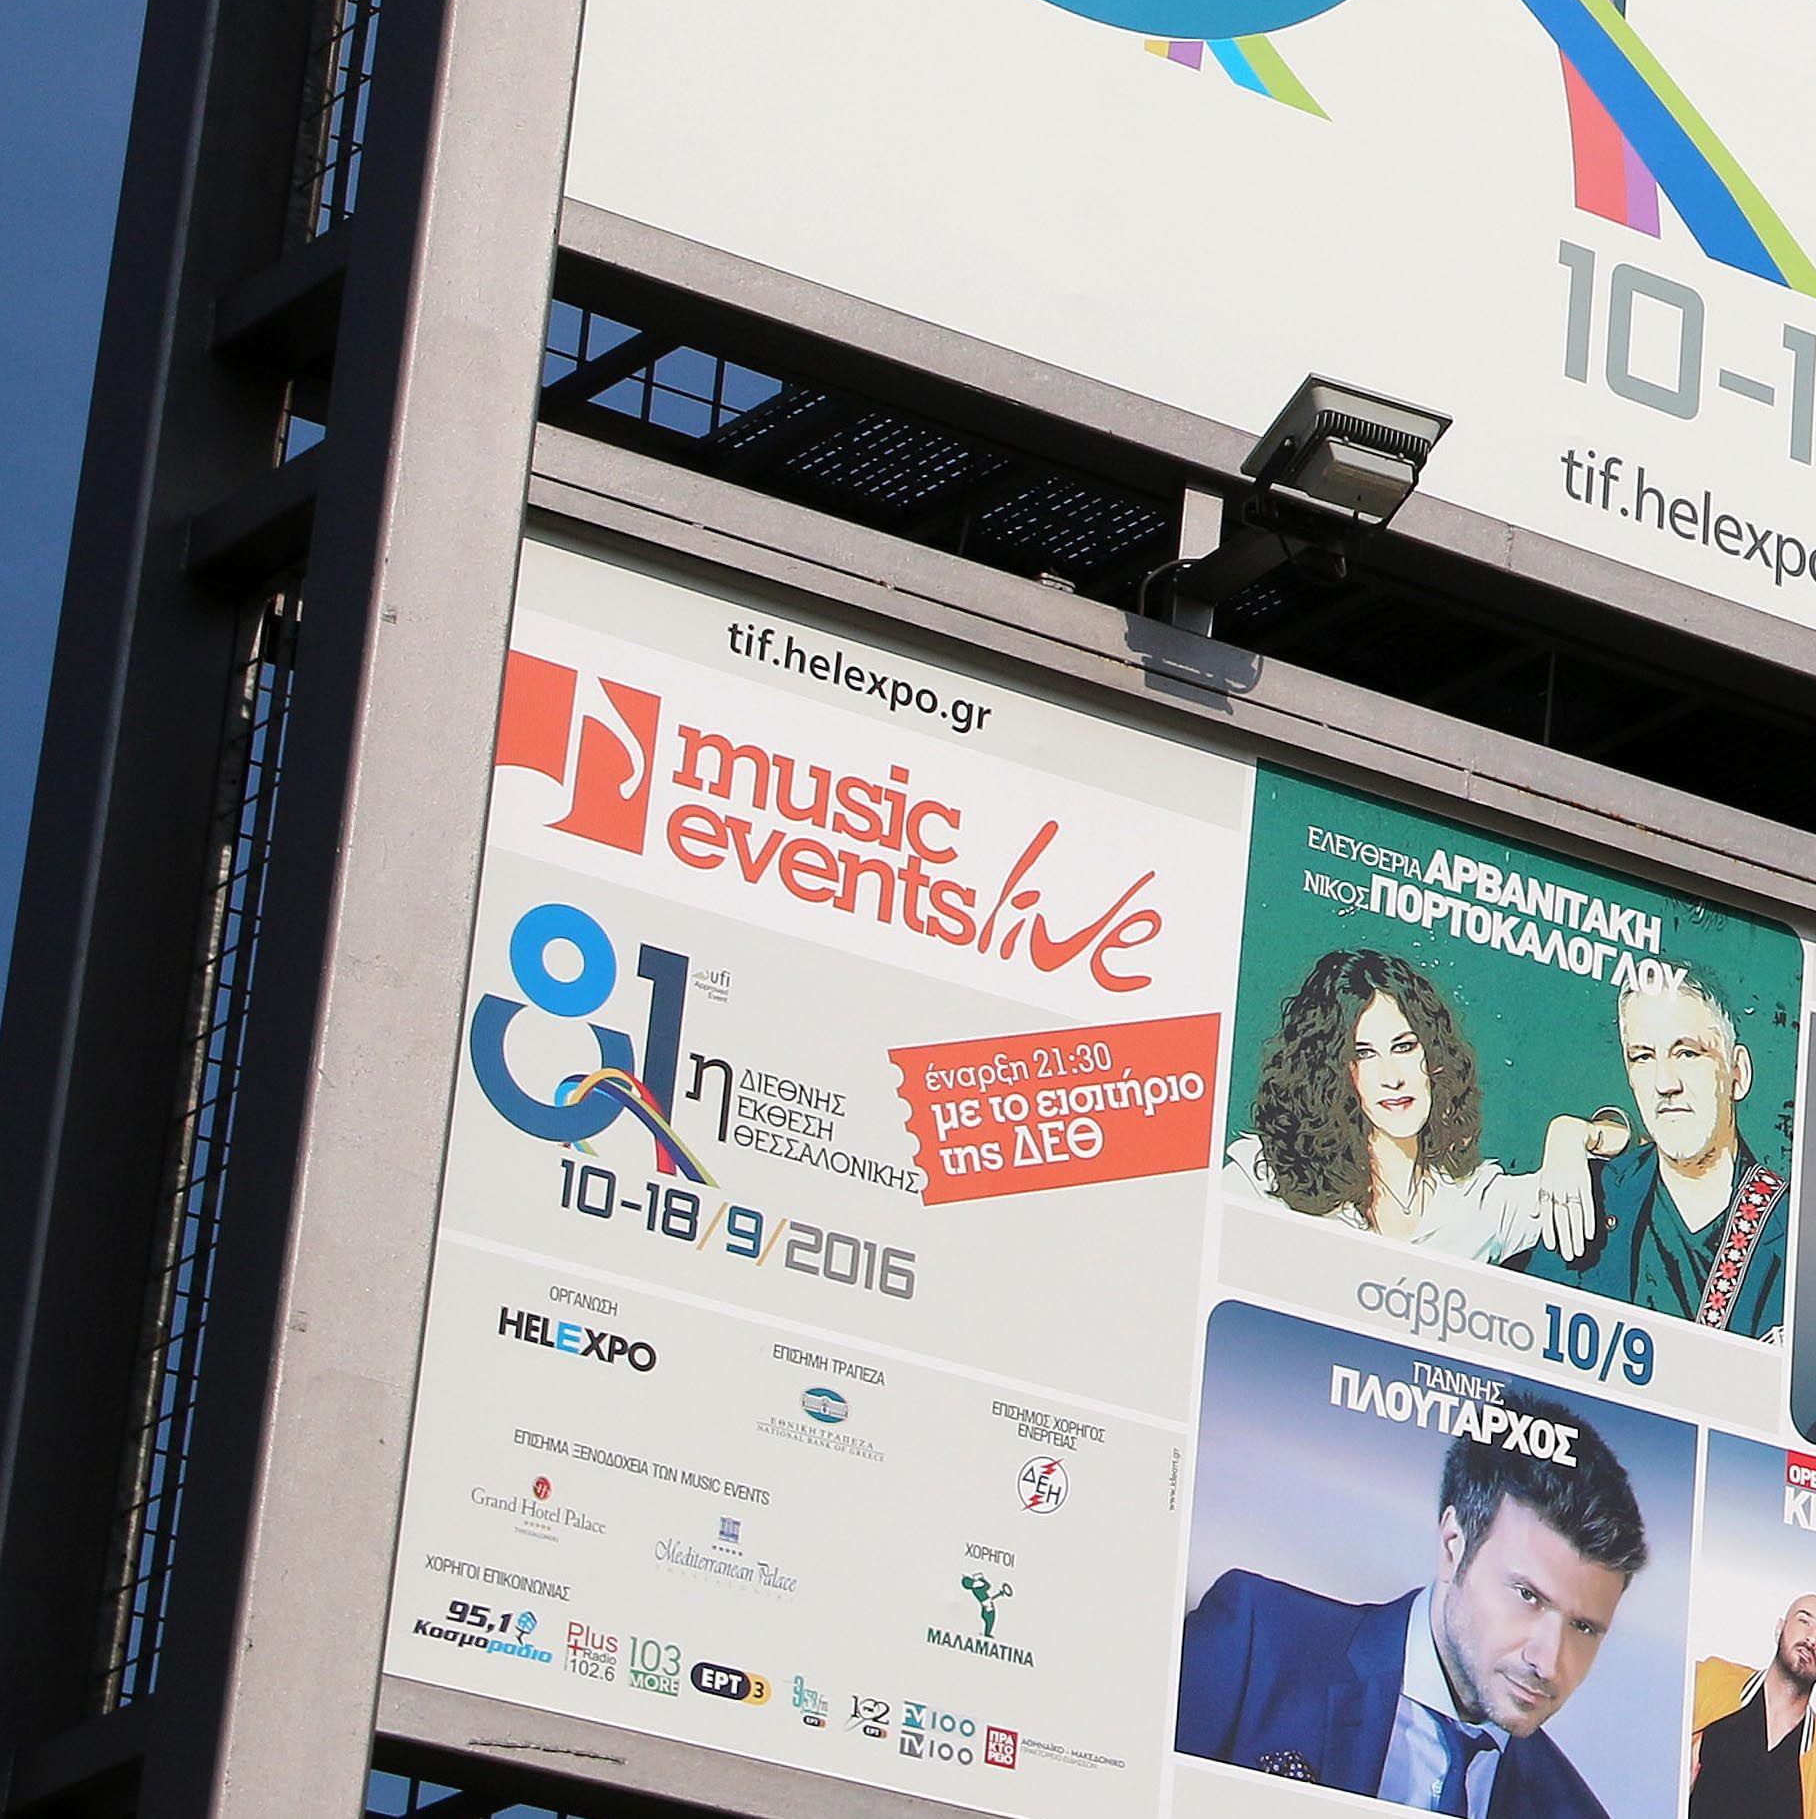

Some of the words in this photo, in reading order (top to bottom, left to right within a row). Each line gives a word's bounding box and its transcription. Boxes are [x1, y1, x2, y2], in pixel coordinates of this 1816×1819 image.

[728, 621, 993, 732] tif.helexpo.gr
[671, 723, 962, 865] music
[666, 803, 979, 947] events
[980, 819, 1163, 993] live
[1308, 826, 1422, 878] ΕΛΕΥΘΕΡΙΑ
[1423, 849, 1663, 955] ΑΡΒΑΝΙΤΑΚΗ
[1303, 870, 1371, 911] ΝΙΚΟΣ
[1369, 874, 1688, 994] ΠΟΡΤΟΚΑΛΟΓΛΟΥ
[924, 1054, 1030, 1093] έναρξη
[1033, 1042, 1112, 1079] 21:30
[739, 1069, 847, 1118] ΔΙΕΘΝΗΣ
[931, 1099, 982, 1142] με
[988, 1091, 1030, 1124] το
[1036, 1068, 1205, 1119] εισιτήριο
[737, 1097, 835, 1142] ΕΚΘΕΣΗ
[733, 1124, 922, 1192] ΘΕΣΣΑΛΟΝΙΚΗΣ
[940, 1141, 1003, 1175] της
[1013, 1117, 1104, 1167] ΔΕΘ
[559, 1158, 917, 1300] 10-18/9/2016
[548, 1285, 619, 1317] ΟΡΓΑΝΩΣΗ
[497, 1307, 657, 1373] HELEXPO
[1356, 1277, 1536, 1353] σάββατο
[1541, 1304, 1655, 1386] 10/9
[773, 1344, 828, 1371] ΕΠΙΣΗΜΗ
[831, 1359, 885, 1386] ΤΡΑΠΕΖΑ
[1412, 1360, 1505, 1407] ΓΙΑΝΝΗΣ
[991, 1401, 1050, 1428] ΕΠΙΣΗΜΟΣ
[1053, 1418, 1106, 1443] ΧΟΡΗΓΟΣ
[1018, 1424, 1077, 1451] ΕΝΕΡΓΕΙΑΣ
[1329, 1364, 1580, 1468] ΠΛΟΥΤΑΡΧΟΣ
[514, 1428, 570, 1457] ΕΠΙΣΗΜΑ
[572, 1443, 649, 1477] ΞΕΝΟΔΟΧΕΙΑ
[653, 1463, 678, 1483] ΤΩΝ
[680, 1469, 721, 1494] MUSIC
[724, 1480, 770, 1506] EVENTS
[1022, 1466, 1062, 1505] ΔΕΗ
[471, 1486, 517, 1514] Grand
[521, 1498, 560, 1523] Hotel
[564, 1509, 606, 1535] Palace
[425, 1554, 480, 1580] ΧΟΡΗΓΟΙ
[482, 1567, 571, 1602] ΕΠΙΚΟΙΝΩΝΙΑΣ
[654, 1539, 754, 1583] Mediterranean
[756, 1560, 798, 1593] Palace
[965, 1542, 1015, 1568] ΧΟΡΗΓΟΙ
[445, 1599, 513, 1633] 95,1
[567, 1621, 619, 1653] Plus
[569, 1659, 616, 1682] 102.6
[629, 1636, 681, 1676] 103
[926, 1627, 1035, 1667] ΜΑΛΑΜΑΤΙΝΑ
[630, 1671, 680, 1696] MORE
